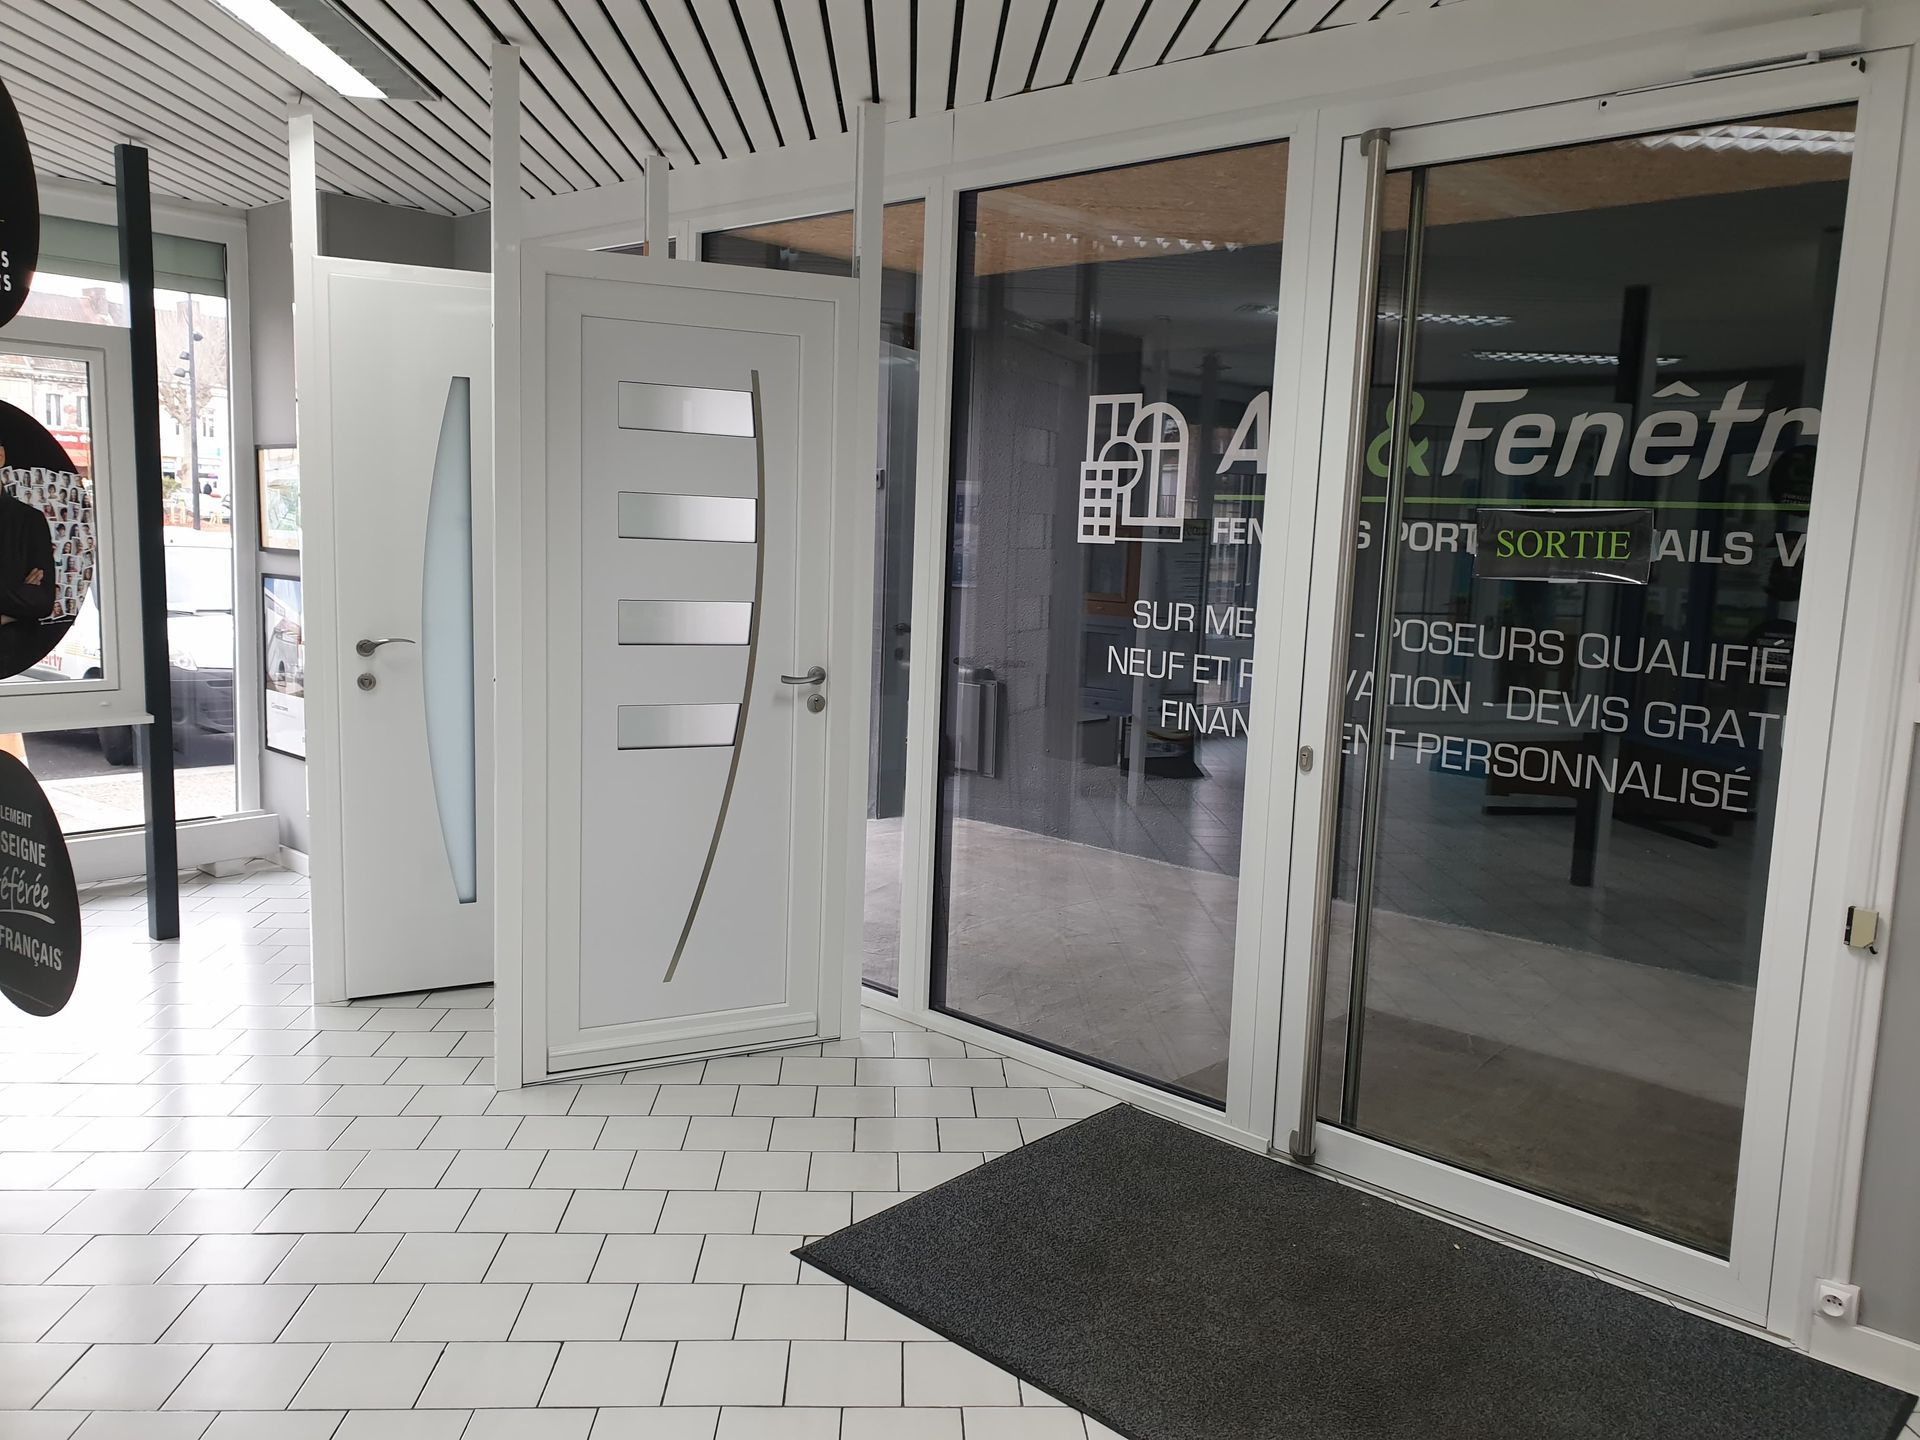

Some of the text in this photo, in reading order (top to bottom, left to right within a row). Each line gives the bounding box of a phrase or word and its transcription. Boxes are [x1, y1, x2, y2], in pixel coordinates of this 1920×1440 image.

[1496, 529, 1632, 561] SORTIE
[1132, 600, 1195, 633] SUR
[1107, 645, 1185, 681] NEUF
[1192, 653, 1231, 686] ET
[1506, 685, 1630, 734] DEVIS
[1643, 701, 1785, 751] GRAT
[1416, 731, 1752, 814] PERSONNALISÉ
